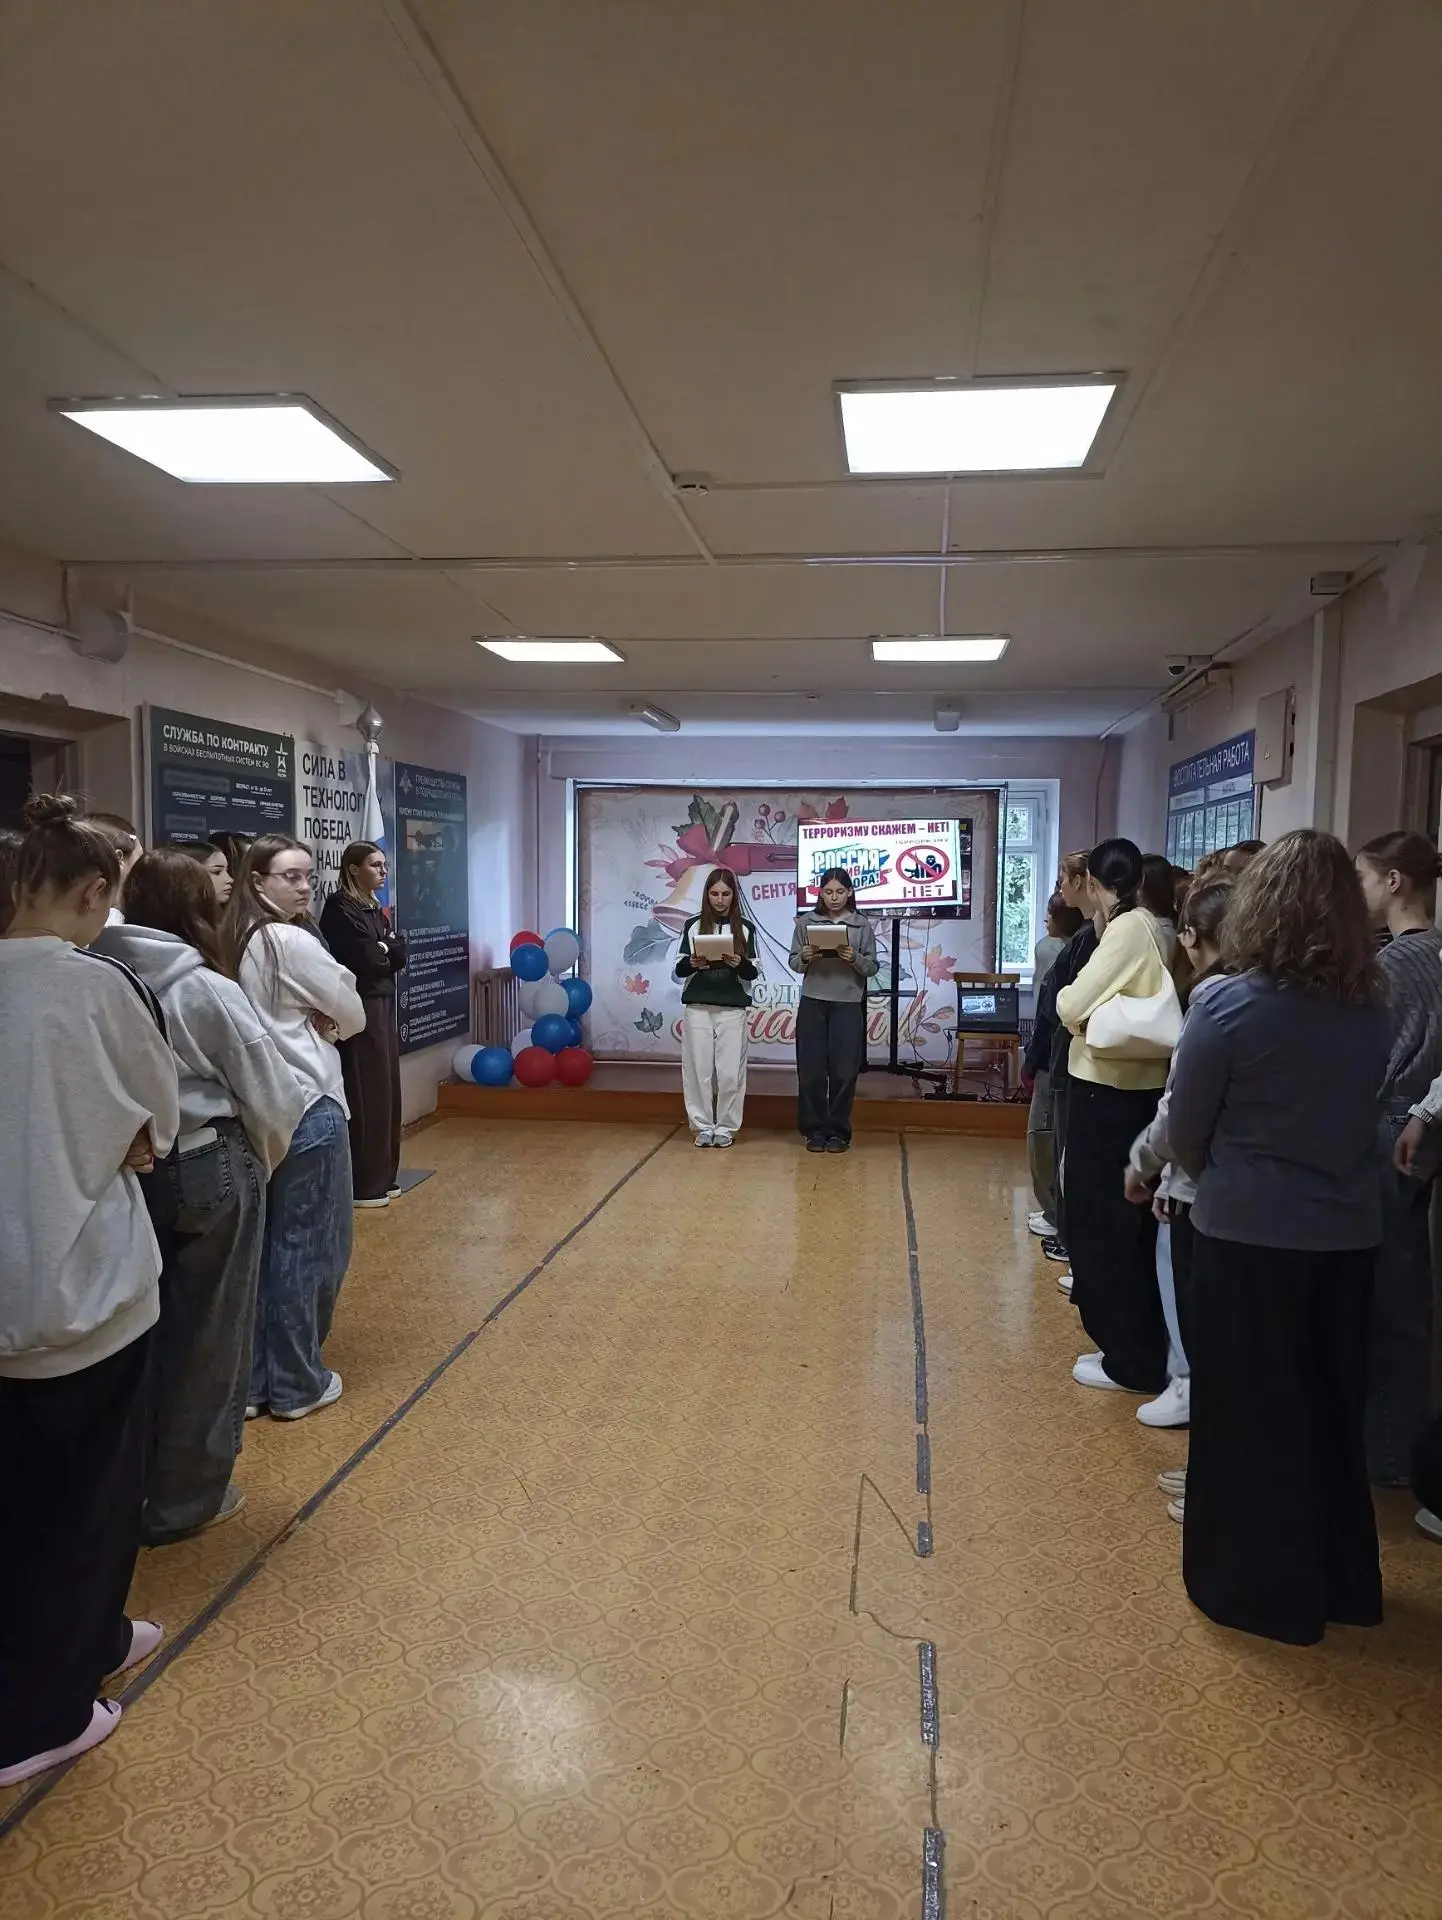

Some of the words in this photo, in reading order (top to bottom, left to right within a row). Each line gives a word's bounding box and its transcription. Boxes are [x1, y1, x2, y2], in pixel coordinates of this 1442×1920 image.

[163, 724, 205, 745] СЛУЖБА
[206, 734, 220, 748] ПО
[221, 737, 269, 757] КОНТРАКТУ
[163, 743, 168, 752] В
[302, 752, 336, 780] СИЛА
[338, 760, 346, 781] В
[1222, 740, 1250, 770] РАБОТА
[304, 818, 351, 844] ПОБЕДА
[803, 825, 869, 839] ТЕРРОРИЗМУ
[871, 823, 916, 836] СКАЖЕМ
[927, 821, 950, 833] НЕТ!
[316, 849, 342, 870] НАШ
[814, 848, 880, 873] РОССИЯ
[751, 882, 797, 900] СЕНТЯ
[903, 884, 945, 898] НЕТ
